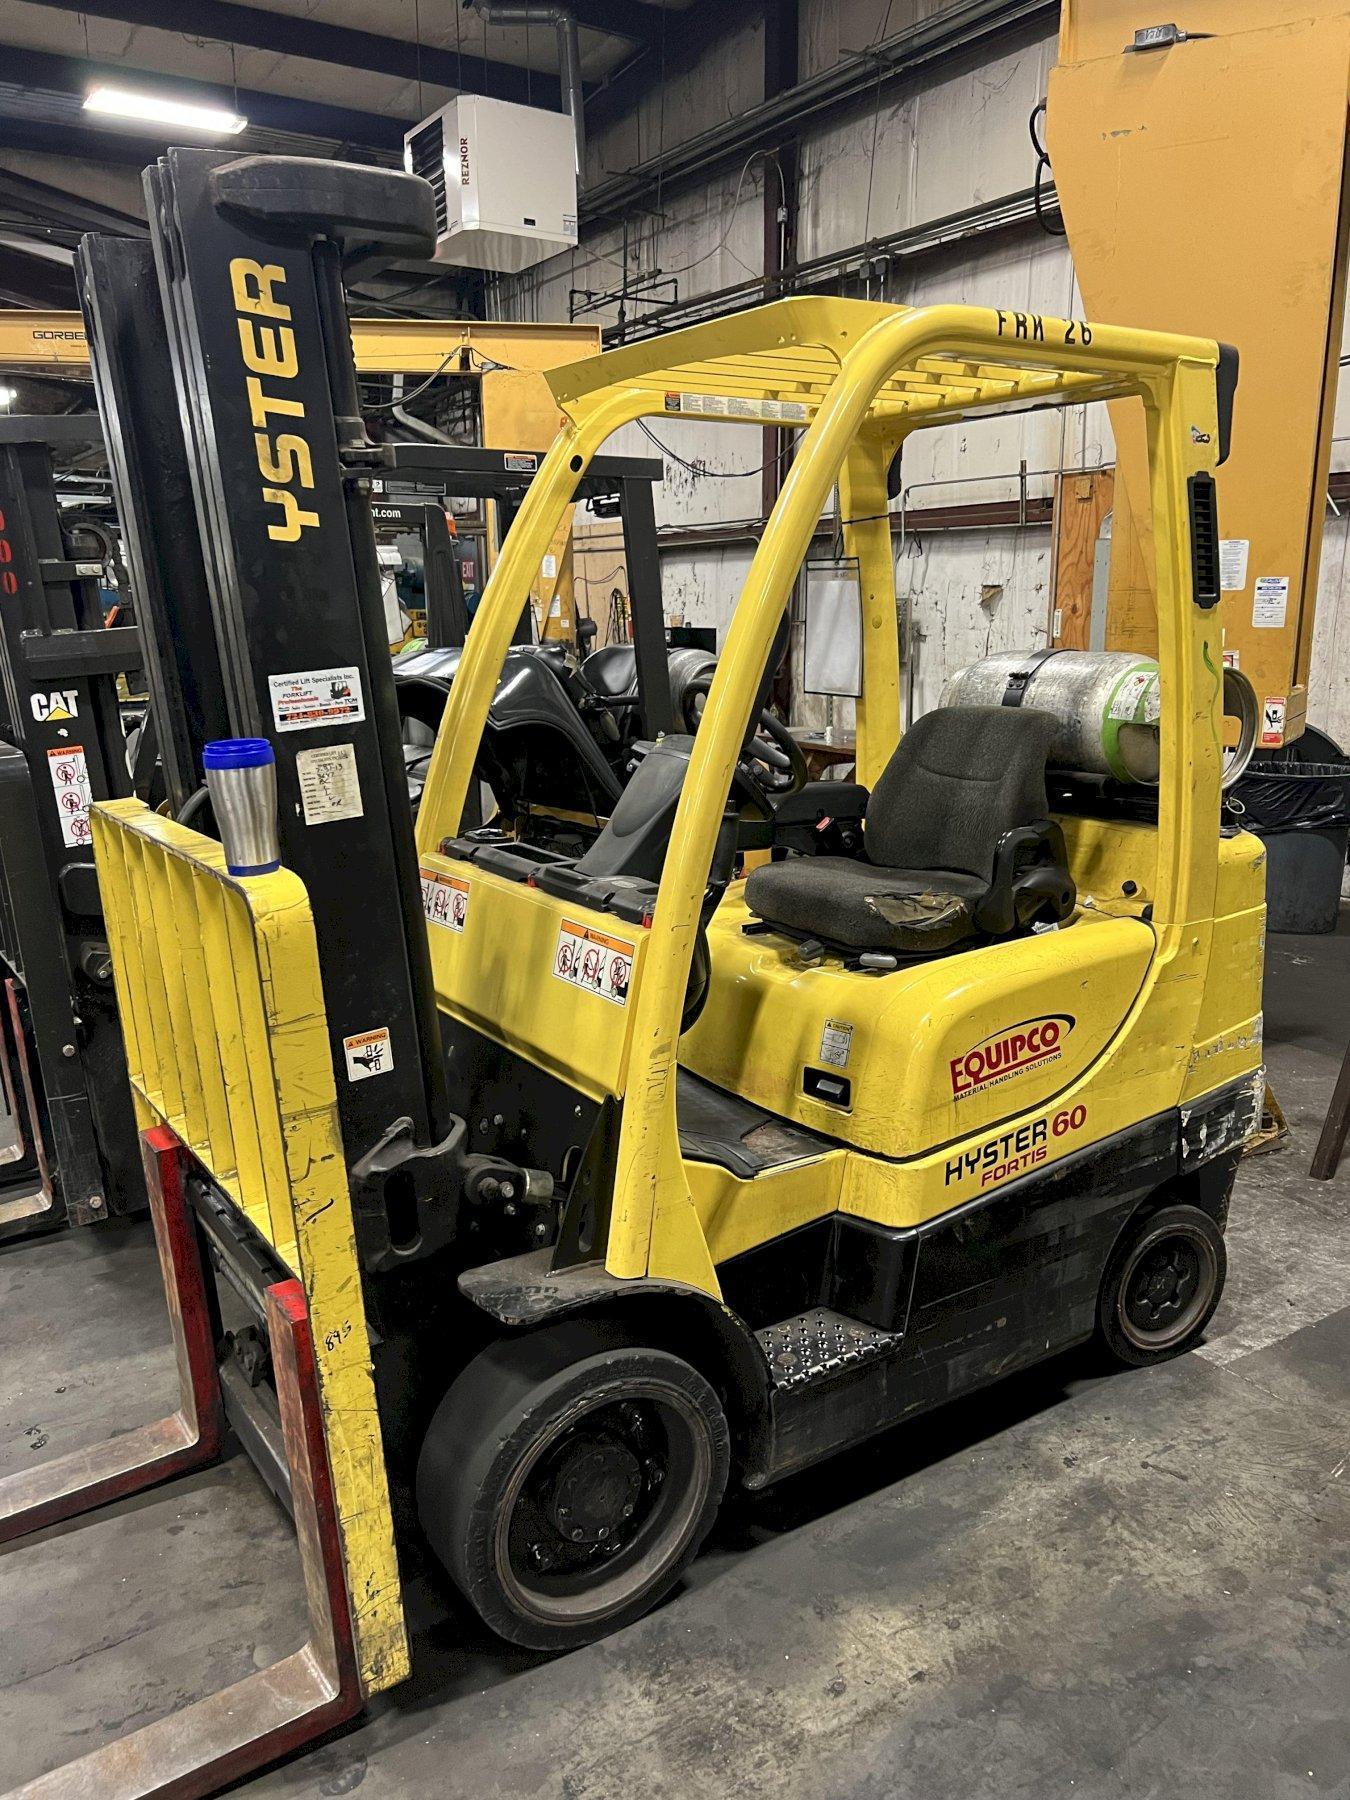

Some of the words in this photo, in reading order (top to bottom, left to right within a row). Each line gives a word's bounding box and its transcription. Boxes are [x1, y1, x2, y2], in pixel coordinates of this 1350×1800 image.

[460, 137, 470, 186] REZNOR
[32, 331, 89, 340] GORBE
[1062, 319, 1092, 346] 26
[229, 257, 321, 543] YSTER
[462, 563, 474, 578] EXIT
[274, 679, 299, 688] Certified
[300, 677, 310, 685] Lift
[312, 675, 342, 684] Specialists
[343, 673, 355, 681] Inc.
[282, 690, 313, 699] FORKLIFT
[30, 690, 78, 721] CAT
[56, 748, 82, 757] WARNING
[356, 1032, 386, 1045] WARNING
[950, 1022, 1060, 1094] EQUIPCO
[953, 1085, 988, 1102] MATERIAL
[989, 1069, 1024, 1088] HANDLING
[1025, 1053, 1062, 1072] SOLUTIONS
[945, 1118, 1048, 1187] HYSTER
[1052, 1104, 1087, 1137] 60
[981, 1145, 1047, 1187] FORTIS
